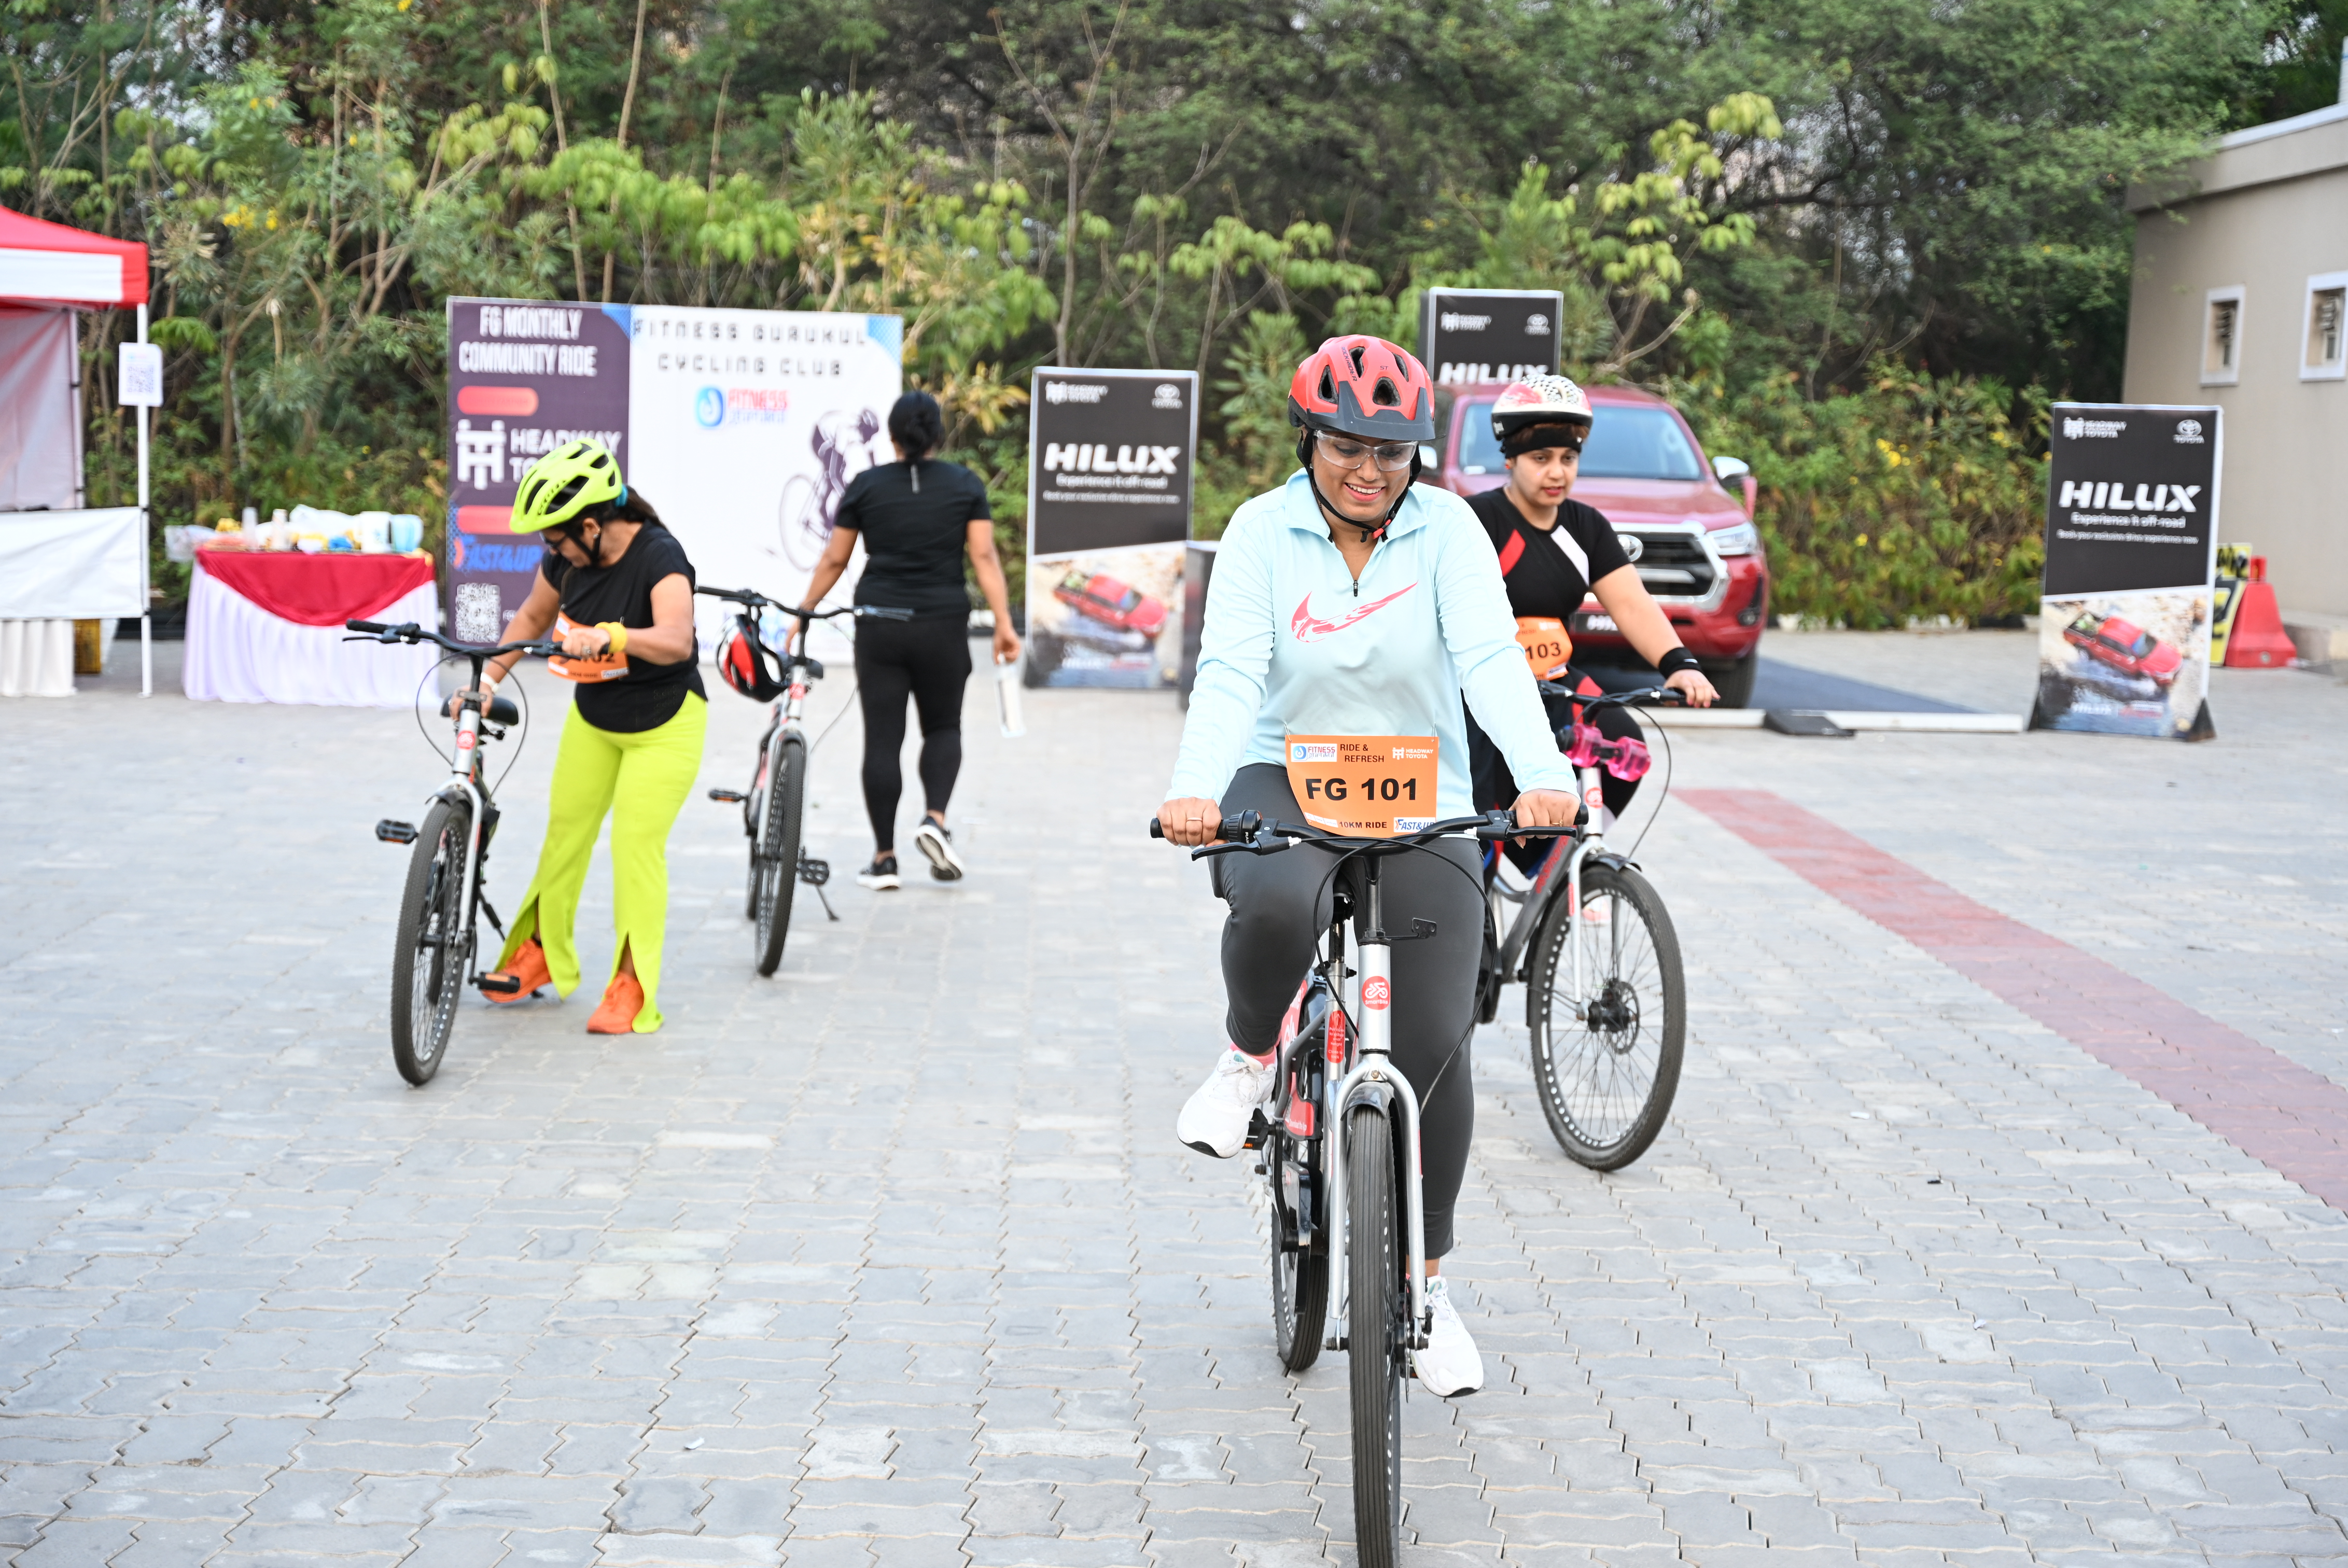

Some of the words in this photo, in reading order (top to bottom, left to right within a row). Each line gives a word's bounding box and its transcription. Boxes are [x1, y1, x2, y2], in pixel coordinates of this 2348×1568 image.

[480, 305, 503, 338] FG
[503, 306, 583, 340] MONTHLY
[633, 319, 740, 340] FITNESS
[753, 325, 865, 345] GURUKUL
[459, 341, 558, 375] COMMUNITY
[558, 344, 598, 377] RIDE
[659, 354, 765, 373] CYCLING
[779, 358, 842, 376] CLUB
[1044, 443, 1182, 474] HILUX
[2058, 480, 2202, 512] HILUX
[1525, 642, 1561, 660] 103
[1305, 778, 1347, 801] FG
[1361, 778, 1417, 801] 101
